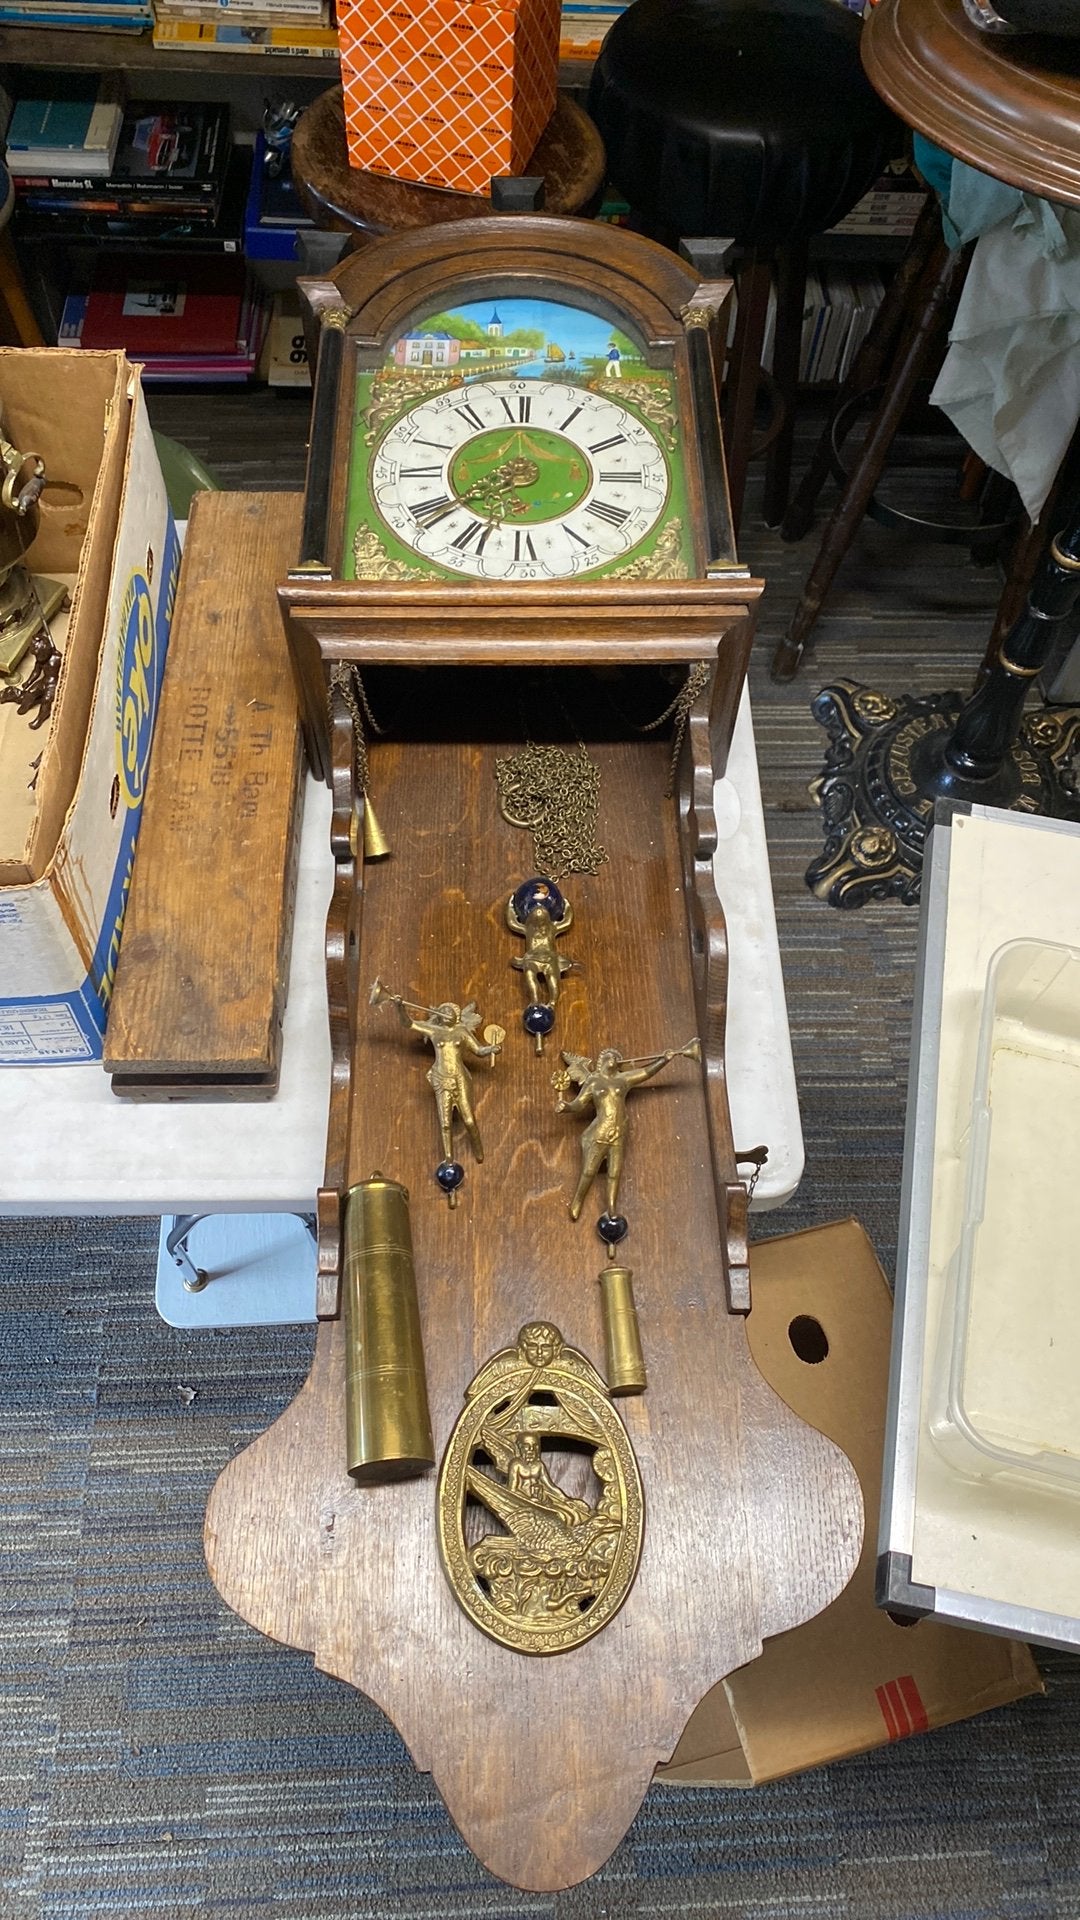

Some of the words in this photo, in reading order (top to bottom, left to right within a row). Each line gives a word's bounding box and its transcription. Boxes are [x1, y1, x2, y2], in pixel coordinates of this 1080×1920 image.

[51, 178, 83, 188] Mercedes
[84, 179, 93, 189] SL
[509, 381, 526, 389] 60
[391, 516, 405, 529] 40
[584, 554, 599, 567] 25
[520, 568, 536, 578] 30
[38, 1047, 86, 1055] BANANAS
